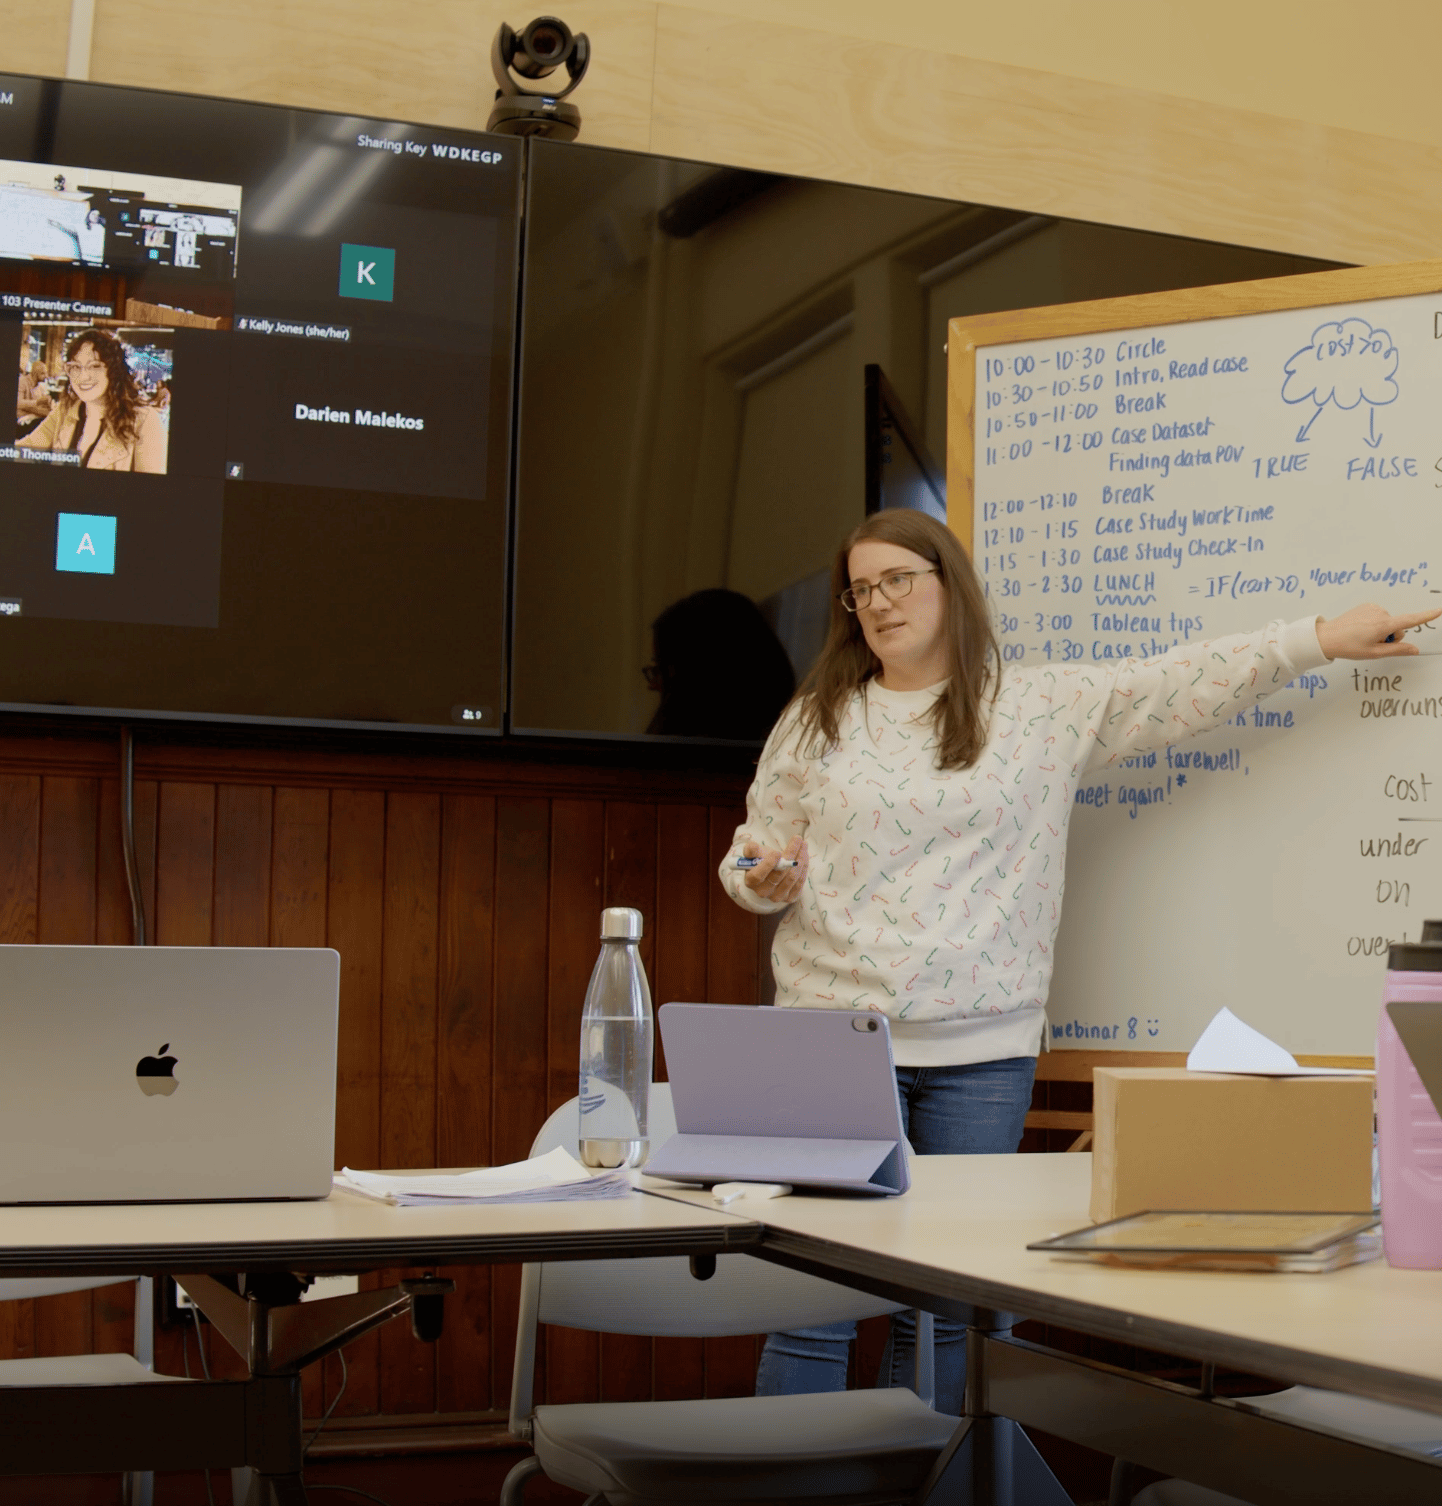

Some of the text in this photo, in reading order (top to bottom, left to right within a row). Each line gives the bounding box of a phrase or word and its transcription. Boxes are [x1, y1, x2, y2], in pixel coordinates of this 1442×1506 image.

[357, 135, 502, 165] Sharing Key WDKEGP
[357, 260, 376, 285] K
[23, 296, 70, 312] Presenter
[72, 301, 112, 316] Camera
[249, 319, 350, 341] Kelly Jones (she/her)
[1116, 337, 1166, 363] Circle
[1115, 366, 1165, 387] Intro,
[1169, 357, 1209, 380] Read
[1213, 355, 1249, 373] case
[1115, 392, 1166, 414] Break
[295, 403, 424, 431] Darien Malekos
[1112, 427, 1146, 444] Case
[1152, 416, 1215, 441] Dataset
[22, 448, 81, 463] Thomasson
[1109, 445, 1244, 477] Finding data POV
[1253, 453, 1418, 481] TRUE FALSE
[1102, 484, 1155, 504] Break
[1096, 517, 1133, 534] Case
[1139, 510, 1187, 536] Study
[76, 532, 95, 555] A
[1094, 546, 1128, 564] Case
[1136, 542, 1183, 569] Study
[1188, 536, 1264, 556] Check-In
[1094, 572, 1155, 592] LUNCH
[1090, 614, 1161, 632] Tableau
[1168, 612, 1203, 639] tips
[1092, 642, 1132, 660] Case
[1351, 668, 1402, 693] time
[1251, 704, 1295, 728] time
[1360, 832, 1429, 857] under
[1376, 879, 1410, 907] on
[1052, 1017, 1138, 1040] webinar 8
